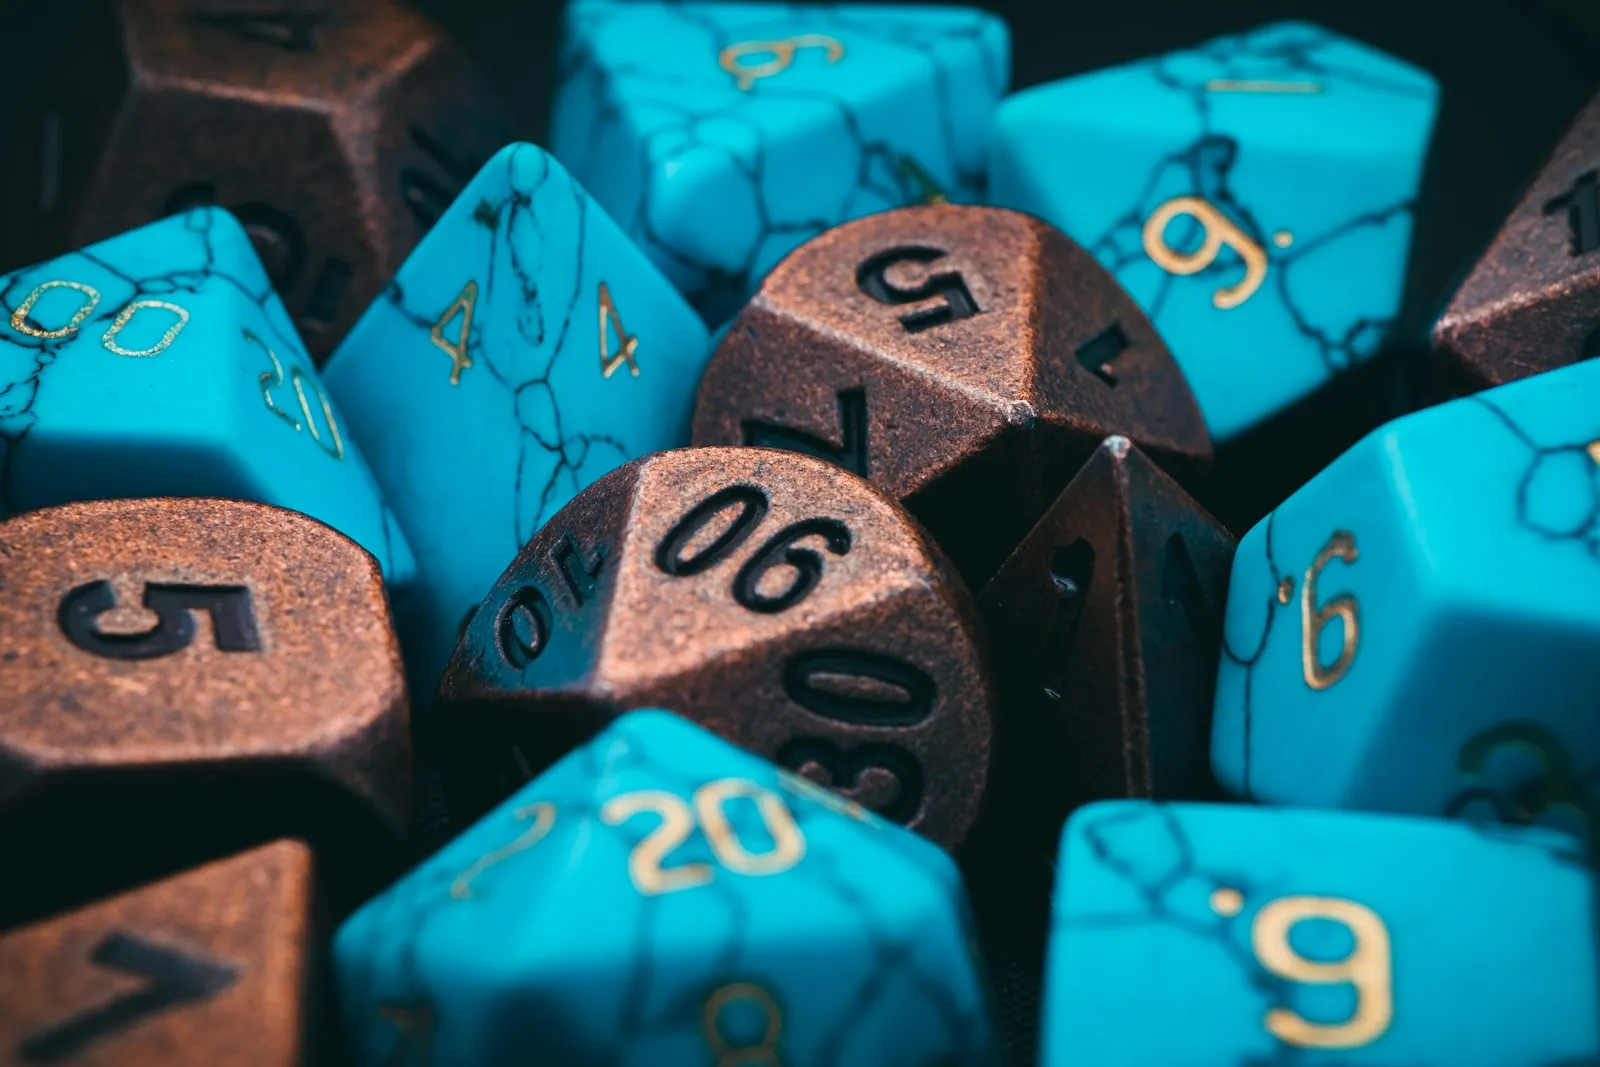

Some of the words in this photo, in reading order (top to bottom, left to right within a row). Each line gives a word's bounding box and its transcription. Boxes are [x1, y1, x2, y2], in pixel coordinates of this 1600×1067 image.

[9, 280, 190, 357] 00
[430, 280, 476, 386] 4
[597, 281, 640, 378] 4
[857, 245, 980, 333] 5
[57, 578, 262, 660] 5
[449, 800, 558, 900] 2
[598, 776, 808, 897] 20
